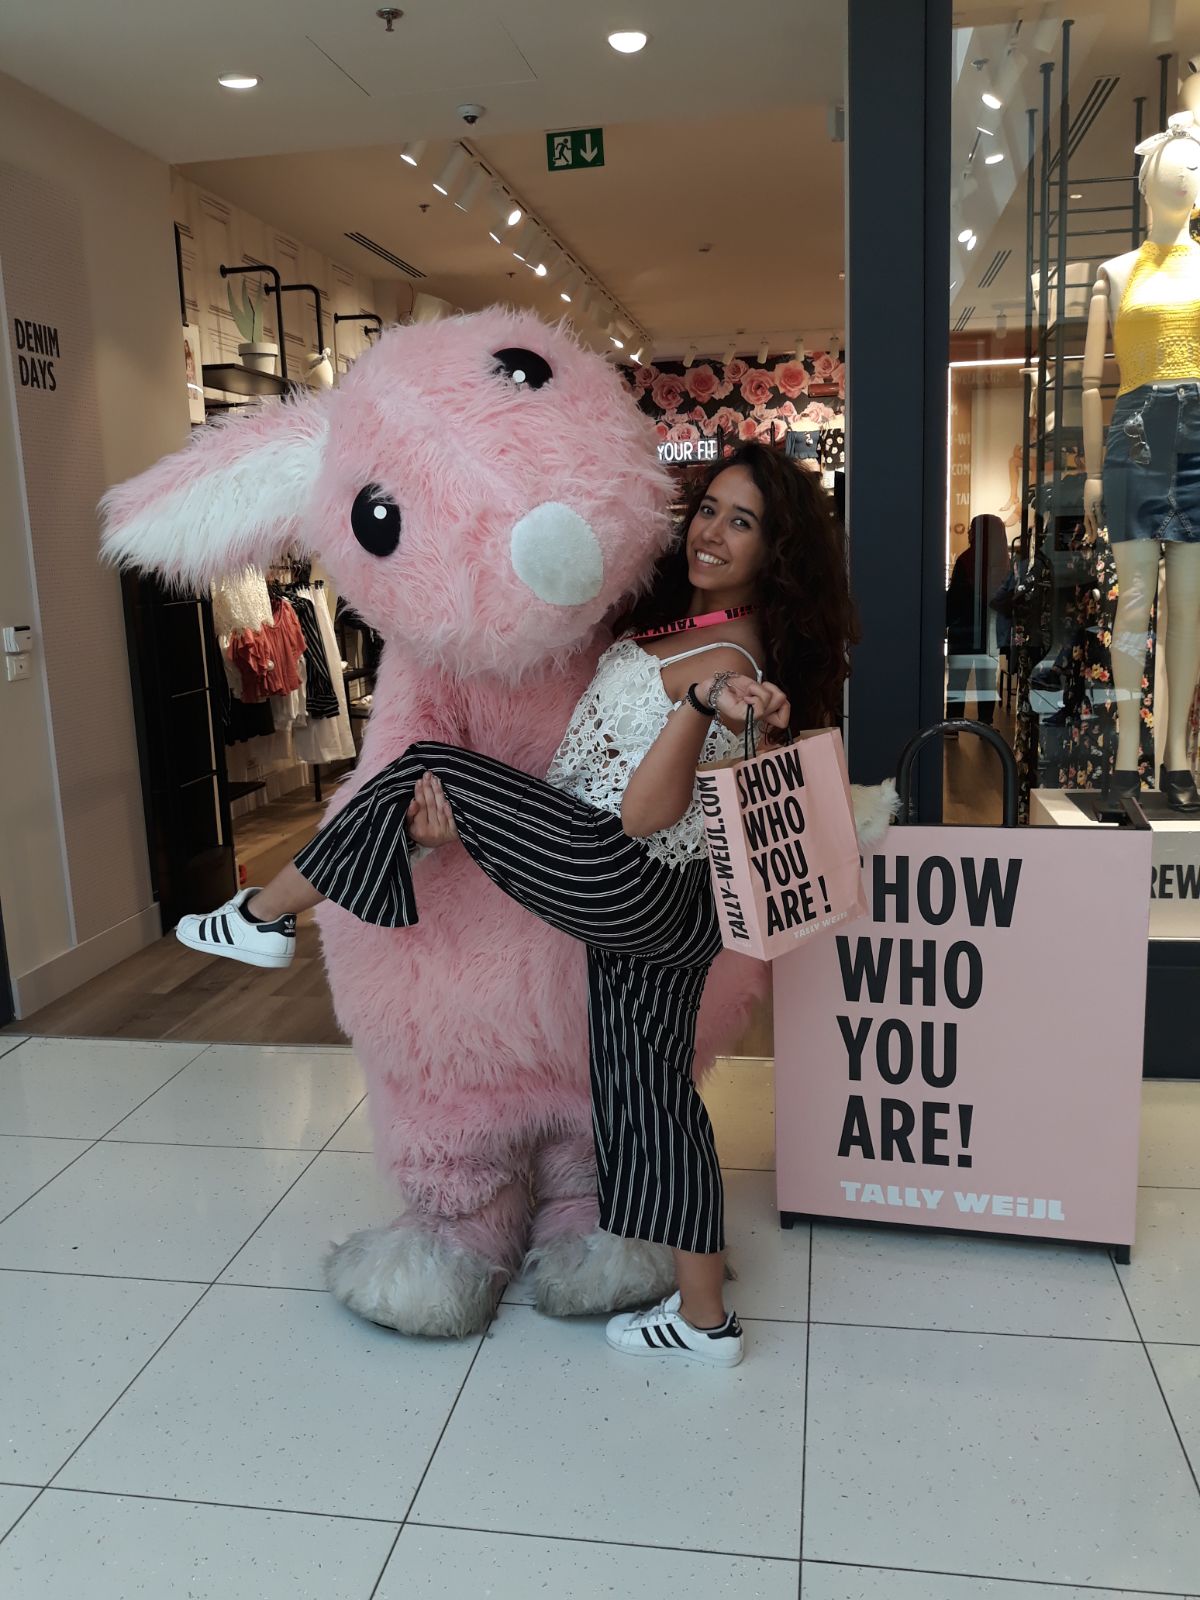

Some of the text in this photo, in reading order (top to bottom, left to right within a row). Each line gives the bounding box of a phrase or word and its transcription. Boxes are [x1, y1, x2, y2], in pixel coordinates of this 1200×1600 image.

[14, 318, 61, 358] DENIM
[18, 355, 57, 392] DAYS
[657, 439, 717, 461] YOUR FIT
[736, 748, 805, 809] SHOW
[743, 795, 805, 851] WHO
[751, 840, 809, 893] YOU
[859, 854, 1023, 928] HOW
[835, 935, 984, 1010] WHO
[835, 1015, 958, 1089] YOU
[837, 1094, 974, 1169] ARE!
[840, 1180, 945, 1212] TALLY
